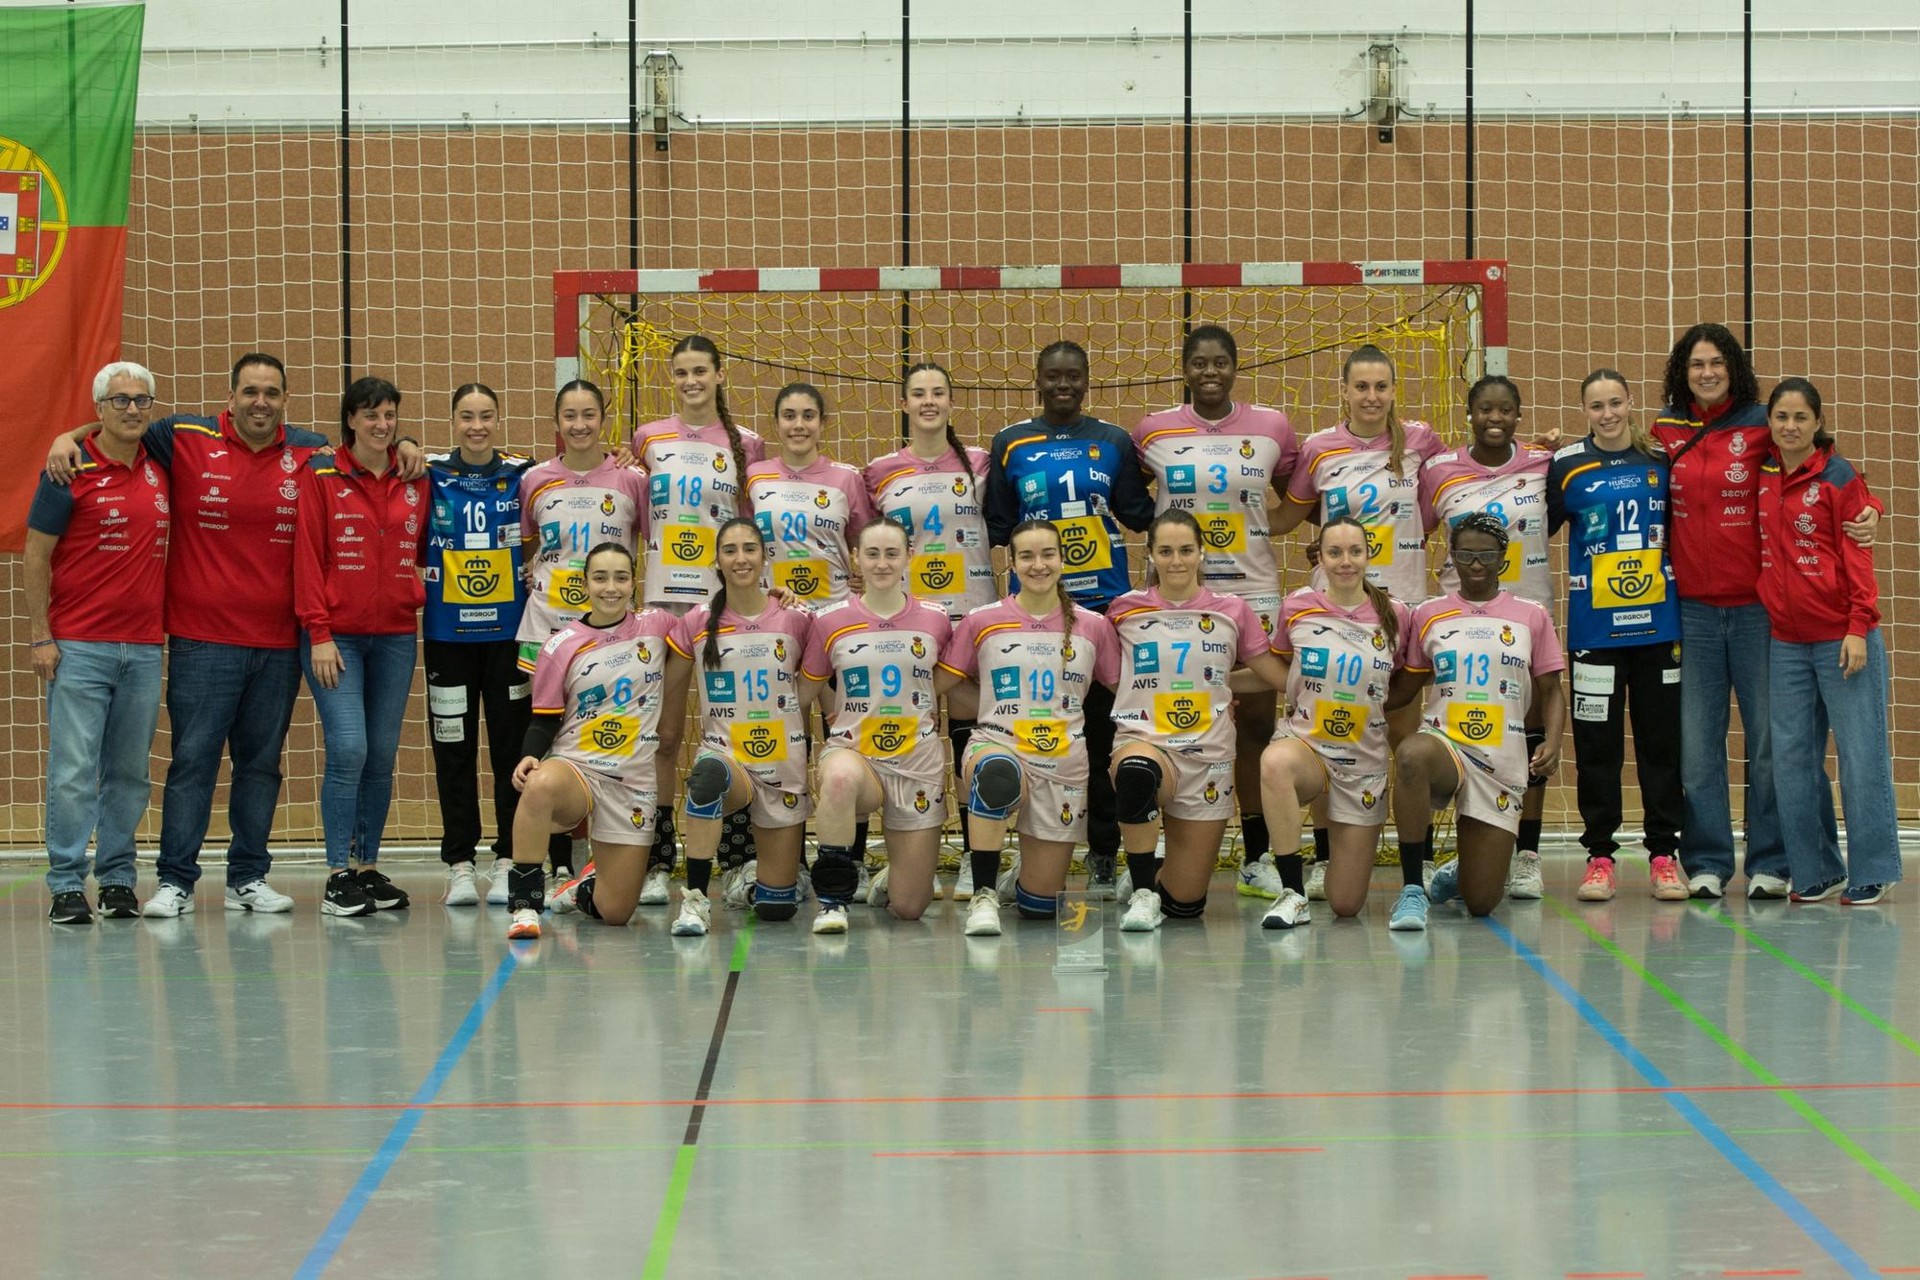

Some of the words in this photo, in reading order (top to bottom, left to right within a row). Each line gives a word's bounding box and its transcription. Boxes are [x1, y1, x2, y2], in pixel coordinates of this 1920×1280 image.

[1208, 464, 1228, 494] 3
[1241, 464, 1264, 478] bms
[677, 475, 702, 508] 18
[712, 478, 738, 496] bms
[1058, 470, 1076, 501] 1
[1170, 498, 1194, 508] AVIS
[1358, 483, 1380, 514] 2
[1514, 494, 1539, 505] bms
[1649, 496, 1666, 511] bm
[463, 500, 486, 532] 16
[955, 503, 978, 515] bms
[1024, 509, 1048, 520] AVIS
[1616, 499, 1640, 531] 12
[1724, 506, 1746, 515] AVIS
[780, 511, 807, 542] 20
[814, 514, 840, 532] bms
[923, 504, 944, 536] 4
[568, 522, 590, 552] 11
[600, 522, 622, 538] bms
[336, 535, 364, 543] cajamar
[430, 536, 454, 549] AVIS
[1796, 556, 1818, 564] AVIS
[1202, 640, 1226, 654] bms
[1170, 642, 1191, 674] 7
[1501, 652, 1526, 668] bms
[644, 670, 662, 684] bms
[1062, 668, 1085, 684] bms
[1336, 652, 1362, 686] 10
[1463, 652, 1490, 687] 13
[742, 668, 769, 702] 15
[880, 664, 902, 698] 9
[1028, 668, 1054, 701] 19
[1132, 678, 1158, 689] AVIS
[1304, 680, 1322, 693] VIS
[612, 676, 632, 706] 6
[577, 710, 598, 720] VIS
[709, 707, 735, 718] AVIS
[844, 702, 868, 712] AVIS
[994, 704, 1019, 716] AVIS
[1110, 712, 1139, 721] elvetia
